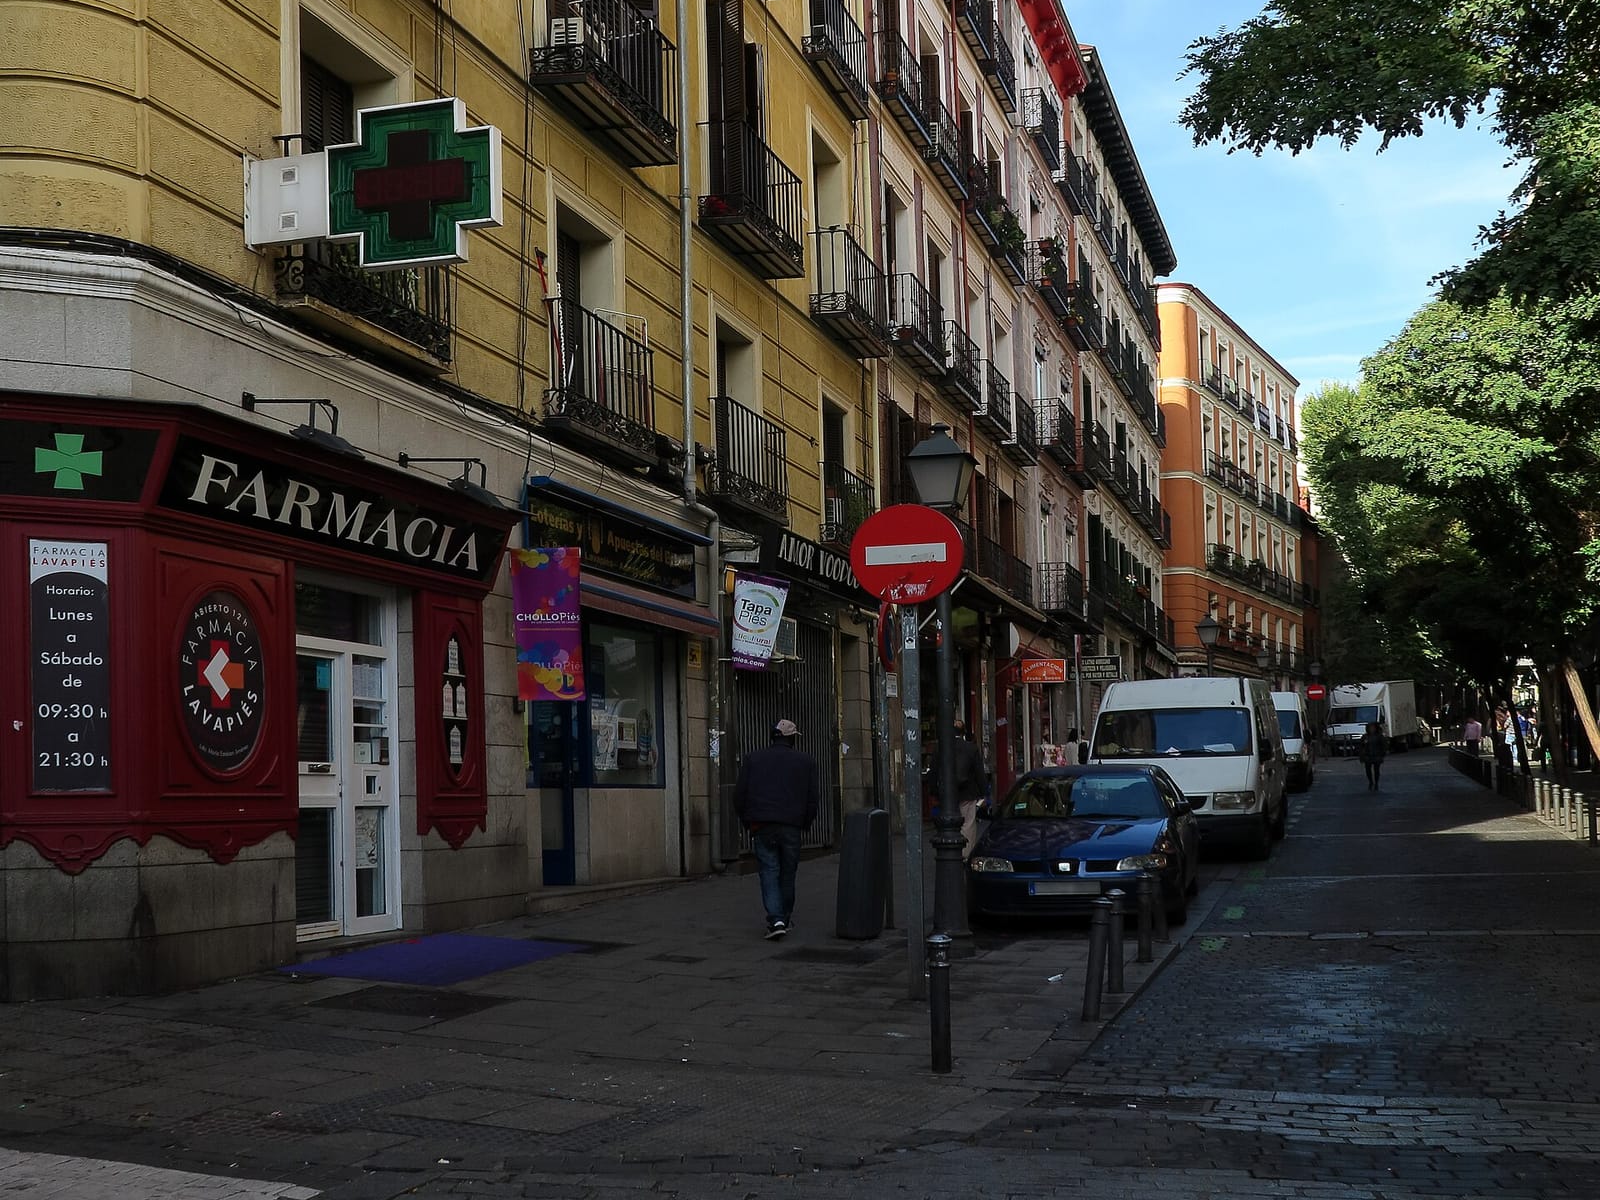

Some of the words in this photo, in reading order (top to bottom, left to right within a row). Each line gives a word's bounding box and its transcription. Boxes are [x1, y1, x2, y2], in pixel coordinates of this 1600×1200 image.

[187, 454, 479, 571] FARMACIA
[33, 547, 105, 557] FARMACIA
[607, 531, 650, 558] Apuestas
[778, 534, 815, 571] AMOR
[46, 585, 95, 596] Horario:
[49, 607, 94, 621] Lunes
[193, 603, 230, 620] ABIERTO
[740, 599, 772, 615] Tapa
[516, 612, 581, 622] CHOLLOPiés
[738, 609, 768, 626] Piés
[66, 633, 77, 643] a
[182, 618, 258, 672] FARMACIA
[40, 651, 103, 666] Sábado
[731, 656, 766, 668] pies.com
[62, 674, 83, 688] de
[38, 703, 94, 719] 09:30
[100, 707, 107, 719] h
[183, 684, 258, 732] LAVAPIÉS
[67, 732, 79, 743] a
[39, 752, 95, 767] 21:30
[100, 755, 108, 767] h
